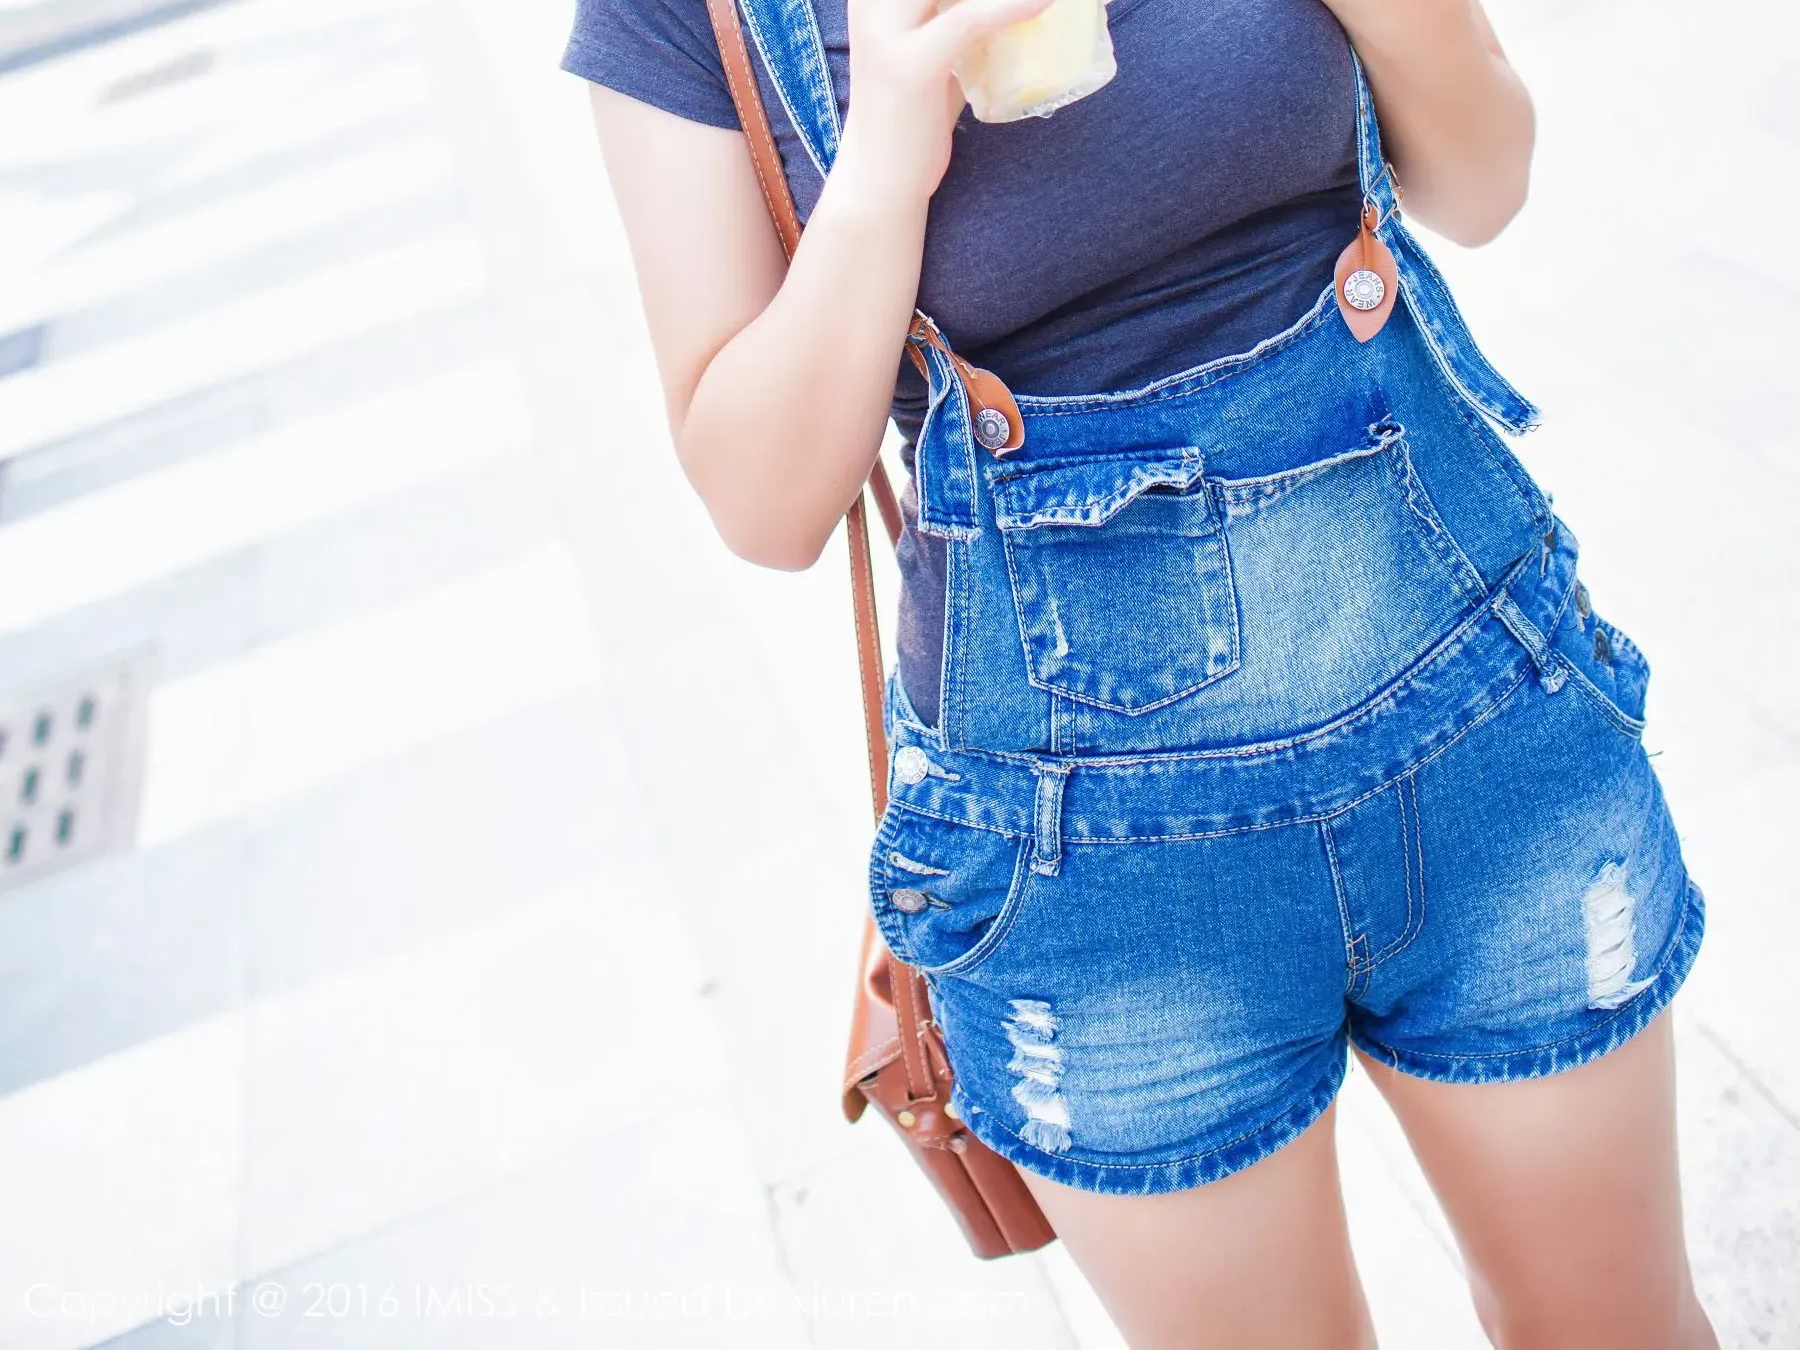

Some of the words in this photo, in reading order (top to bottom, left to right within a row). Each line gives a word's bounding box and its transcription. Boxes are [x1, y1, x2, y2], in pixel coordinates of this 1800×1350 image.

[1353, 271, 1384, 293] JEANS
[1345, 289, 1376, 308] WEAR
[976, 411, 1005, 426] WEAR
